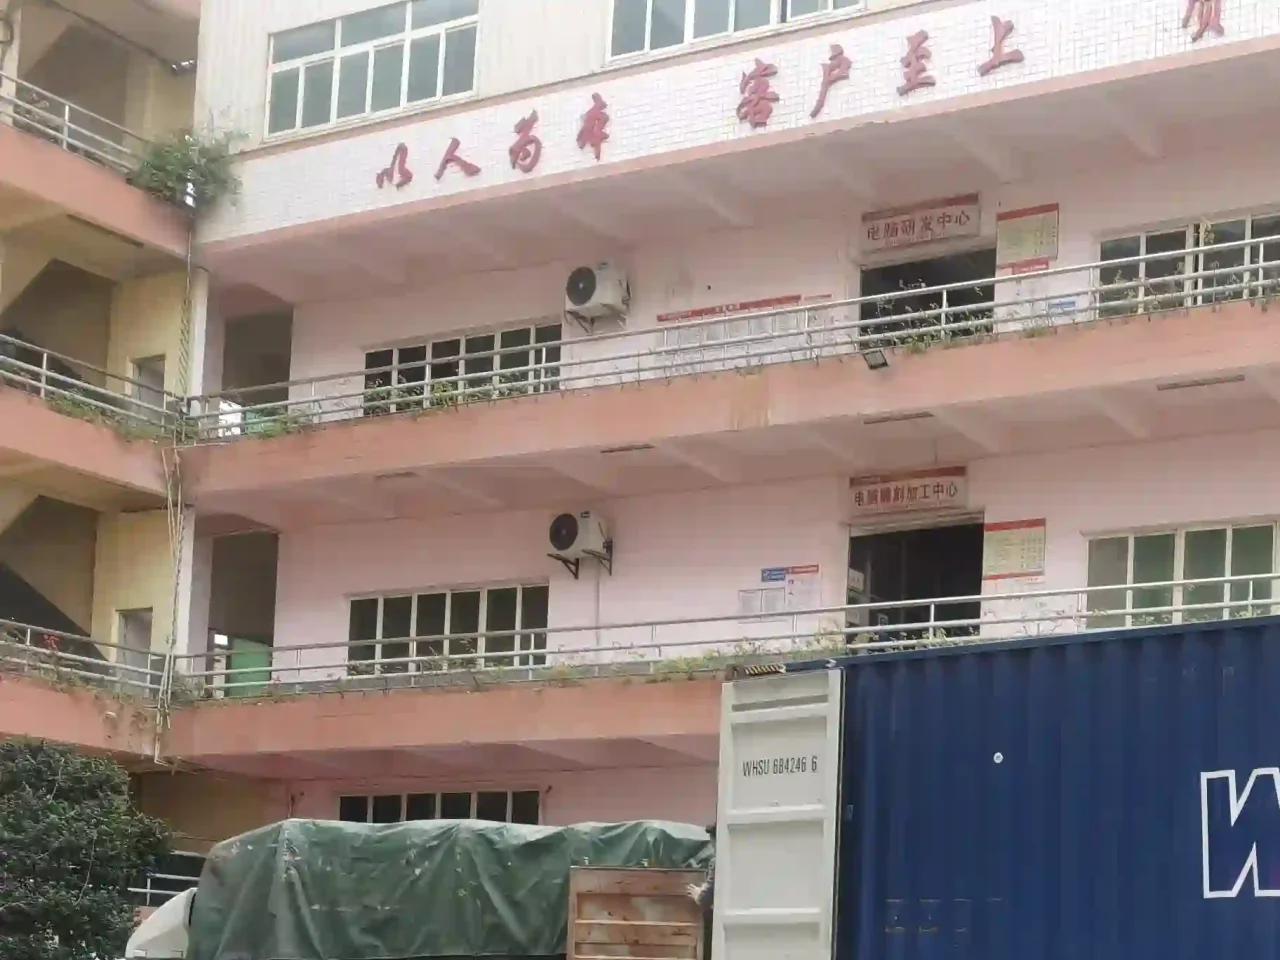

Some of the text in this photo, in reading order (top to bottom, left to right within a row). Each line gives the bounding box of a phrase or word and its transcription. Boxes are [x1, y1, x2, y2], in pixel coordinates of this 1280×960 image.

[735, 15, 1025, 128] 客户至上
[743, 759, 770, 777] WHSU
[773, 756, 807, 775] 684246
